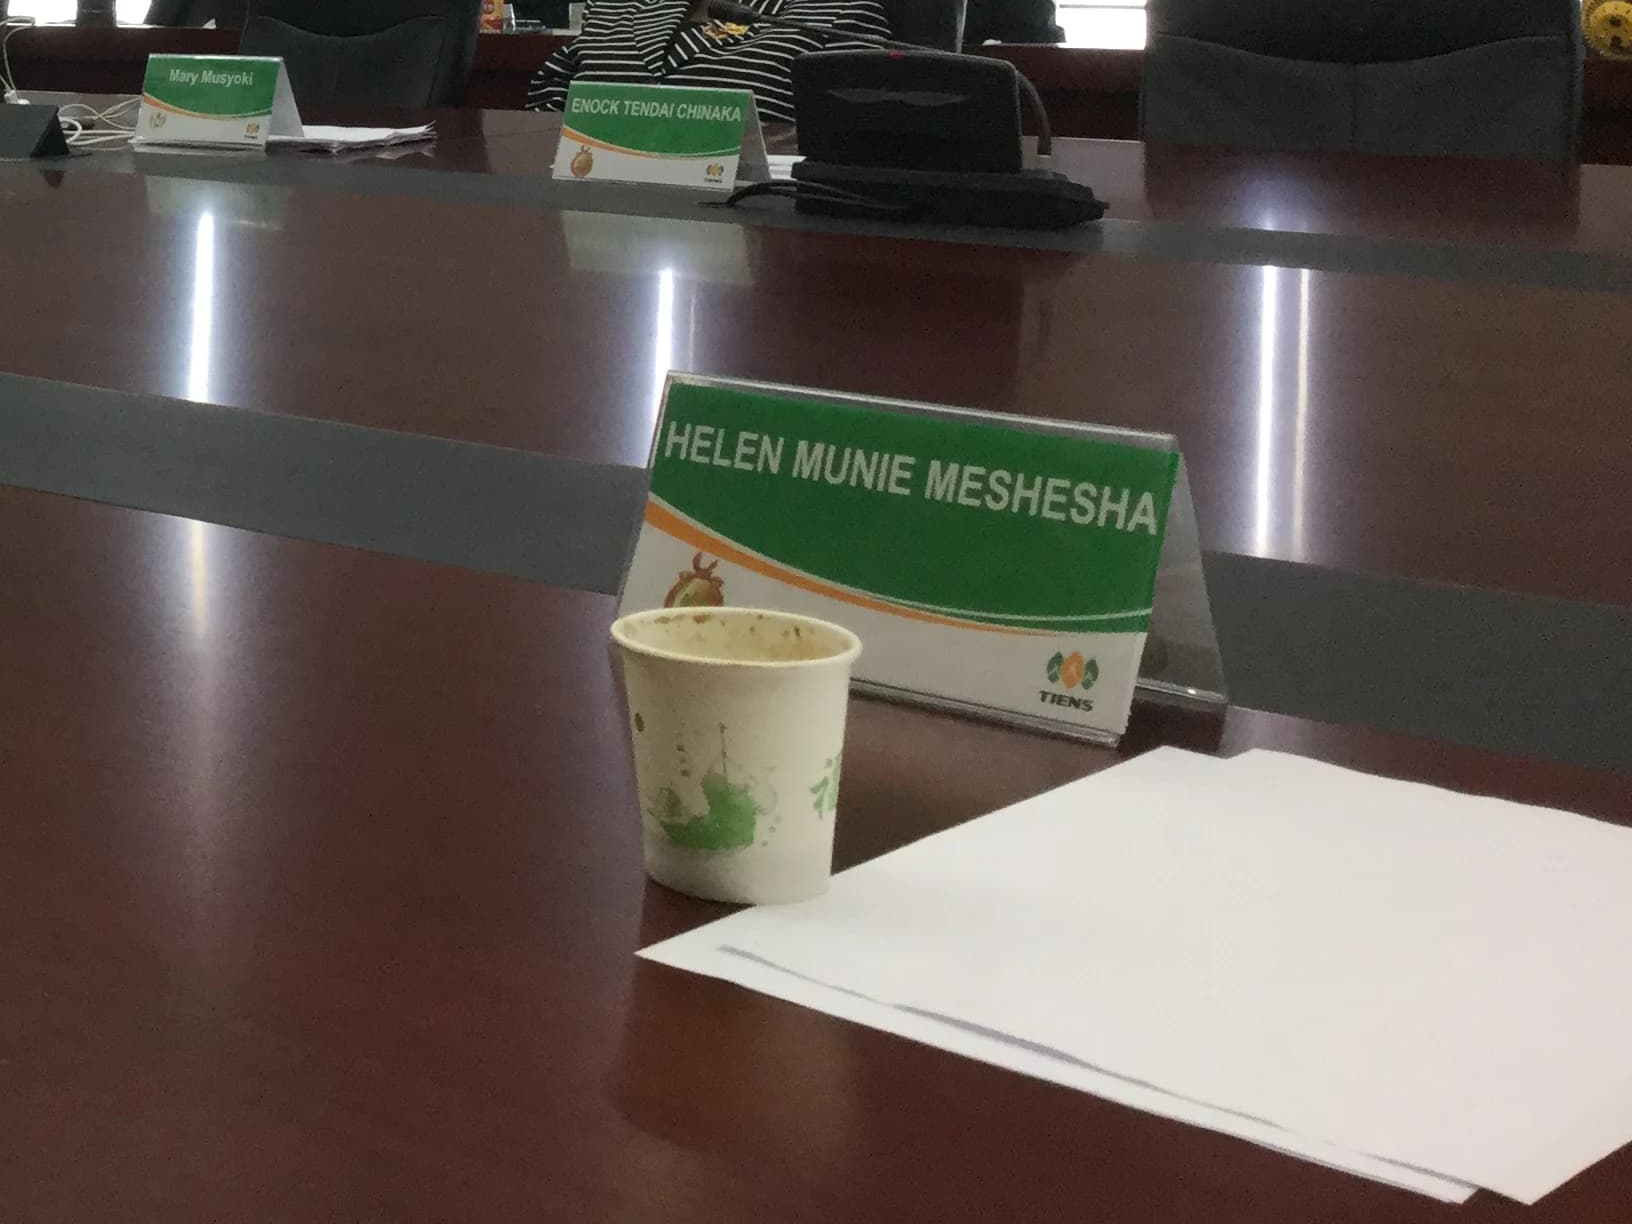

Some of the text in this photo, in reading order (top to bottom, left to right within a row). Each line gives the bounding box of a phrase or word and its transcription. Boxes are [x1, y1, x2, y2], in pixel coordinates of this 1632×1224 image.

[169, 69, 254, 87] Mary Musyoki
[571, 97, 742, 122] ENOCK TENDAI CHINAKA
[664, 421, 1159, 536] HELEN MUNIE MESHESHA
[1038, 690, 1094, 712] TIENS
